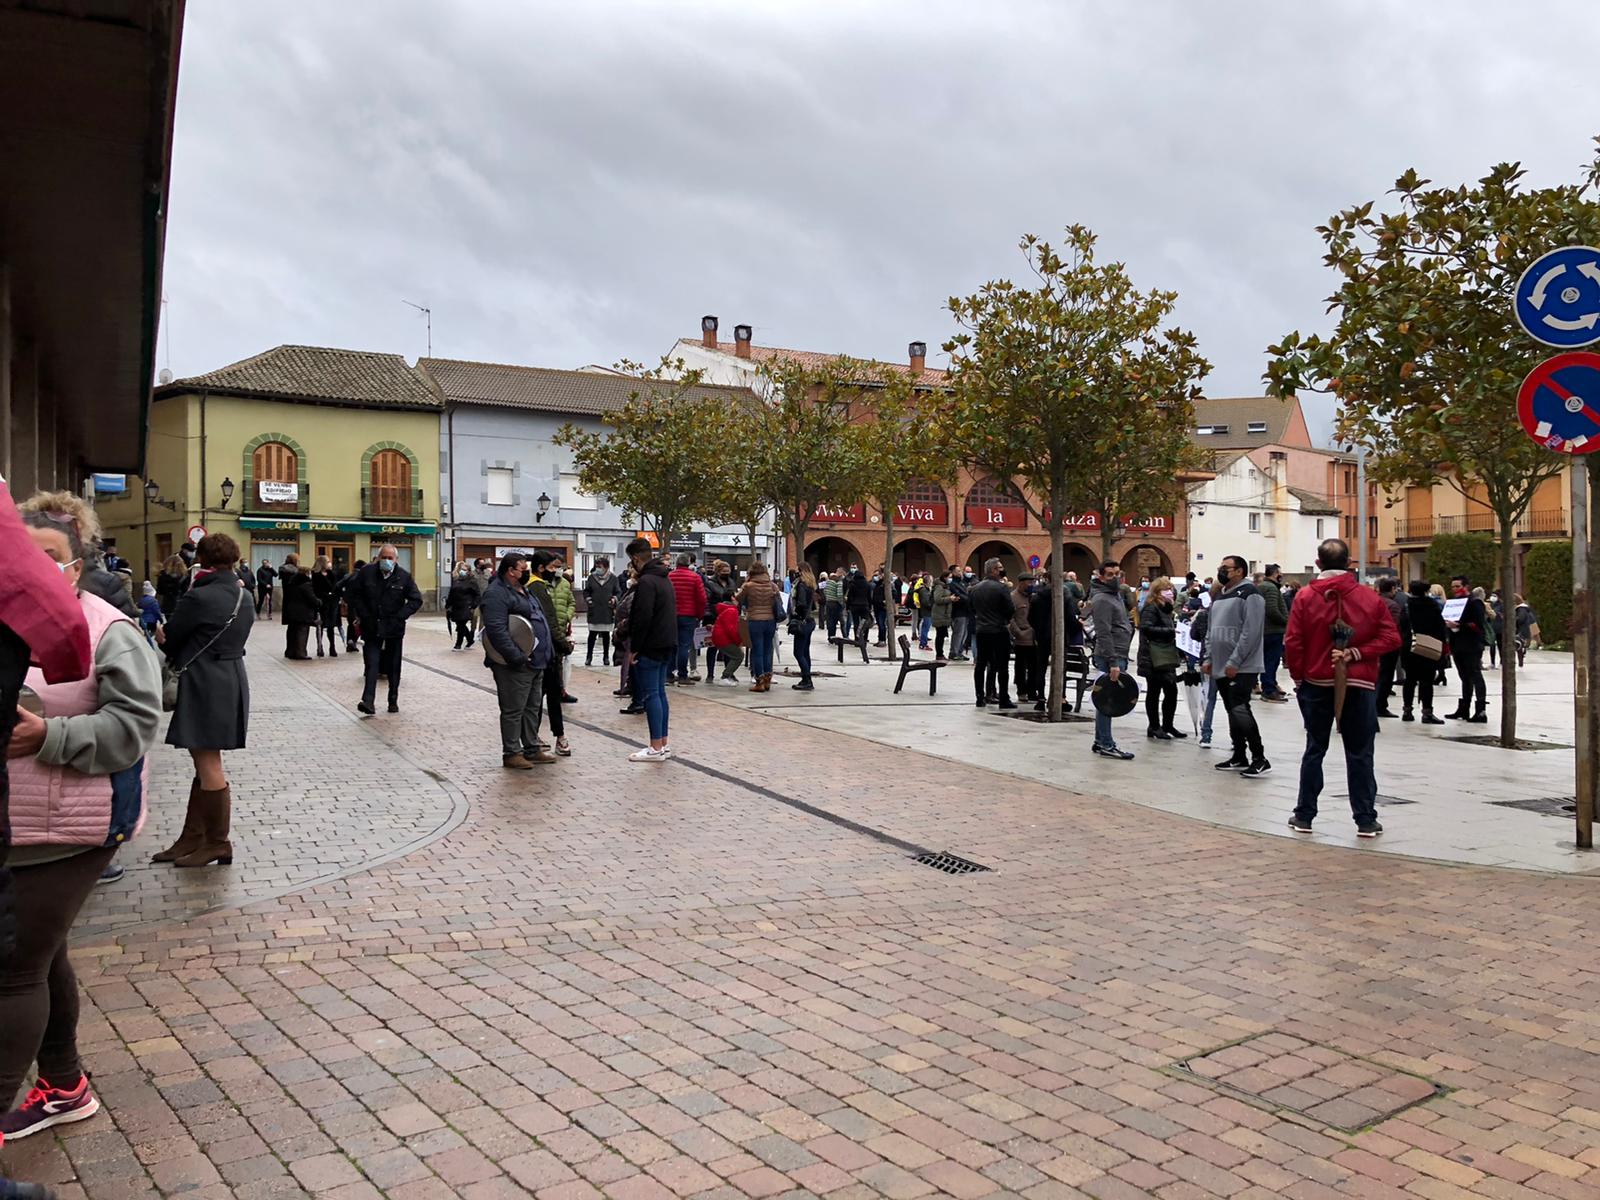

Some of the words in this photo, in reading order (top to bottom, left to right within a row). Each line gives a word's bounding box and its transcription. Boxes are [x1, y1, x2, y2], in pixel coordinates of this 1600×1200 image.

[897, 504, 934, 521] Viva
[986, 508, 1003, 523] la
[309, 523, 338, 531] PLAZA
